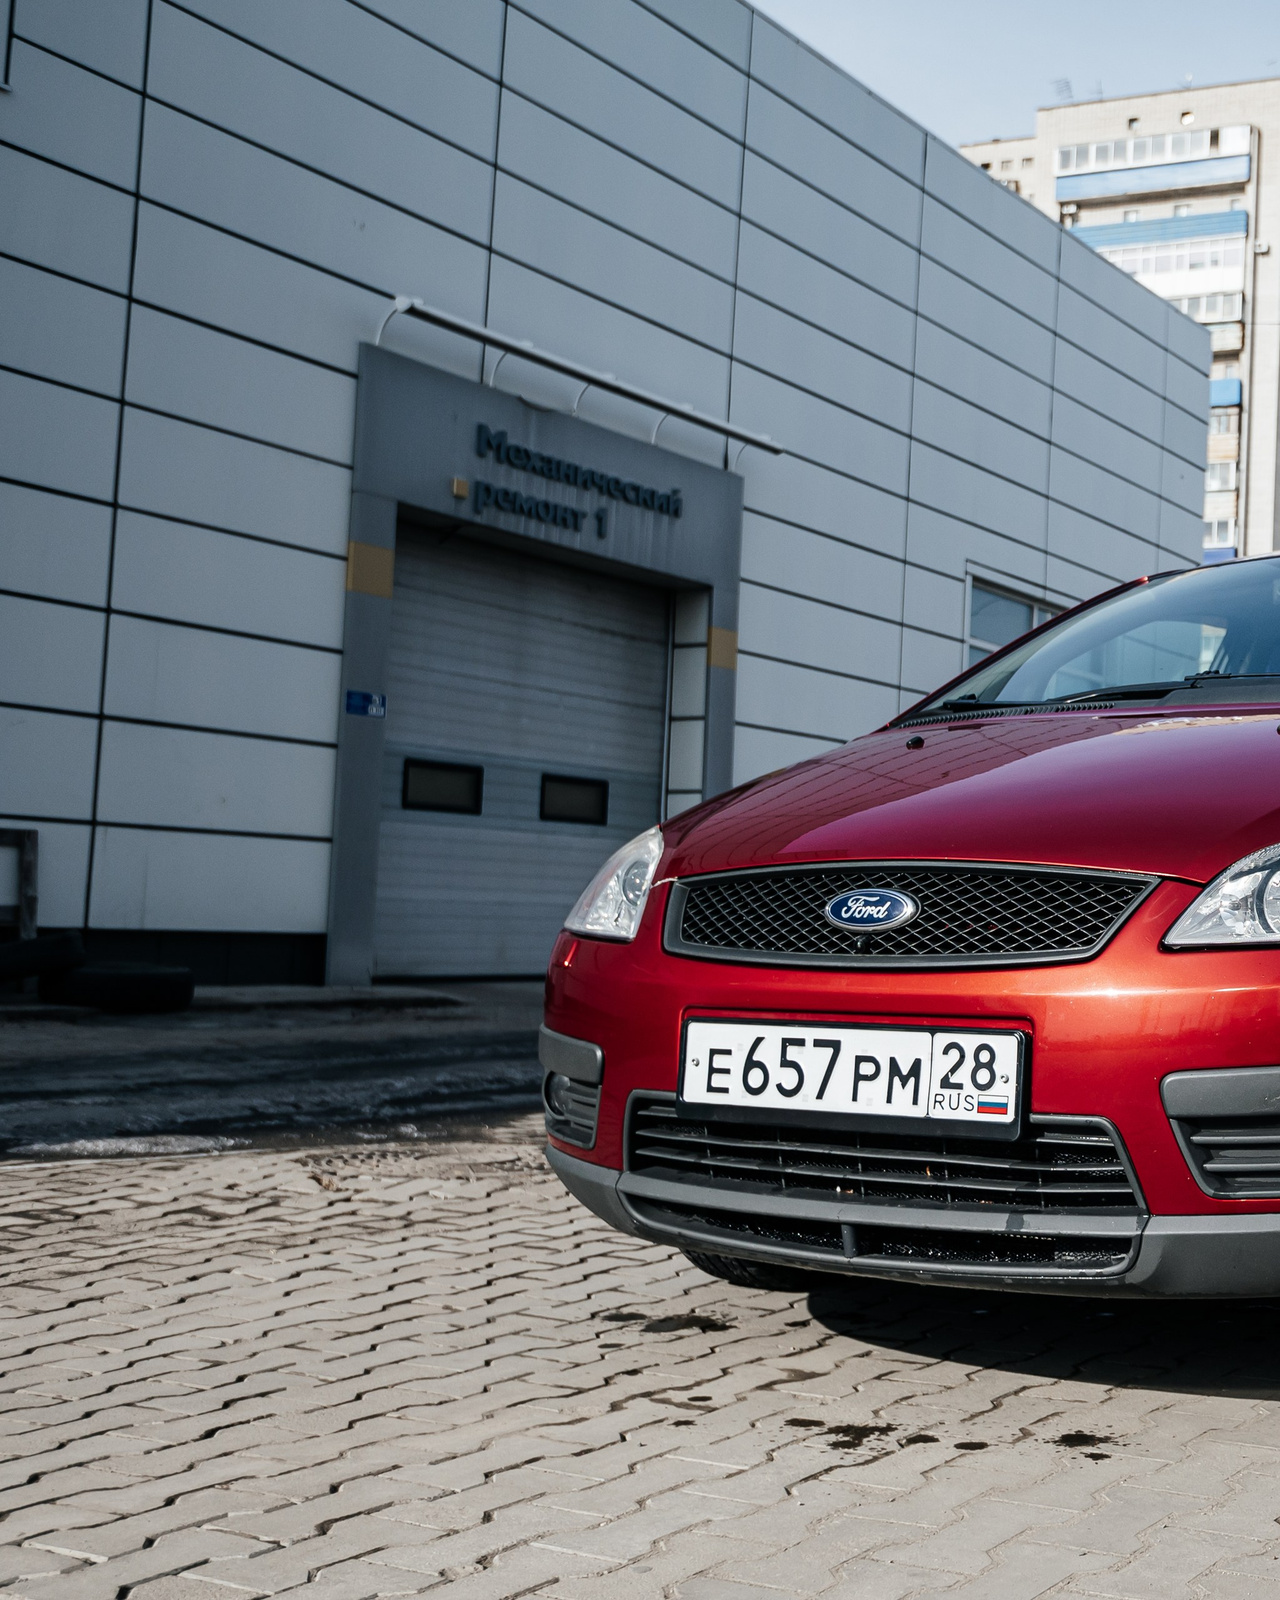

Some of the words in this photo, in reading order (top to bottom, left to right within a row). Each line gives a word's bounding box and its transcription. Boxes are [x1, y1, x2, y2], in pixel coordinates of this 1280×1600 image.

[475, 422, 683, 519] Механический
[473, 480, 588, 533] ремонт
[595, 507, 608, 540] 1
[841, 895, 891, 919] Ford
[940, 1042, 996, 1091] 28
[933, 1093, 975, 1112] RUS
